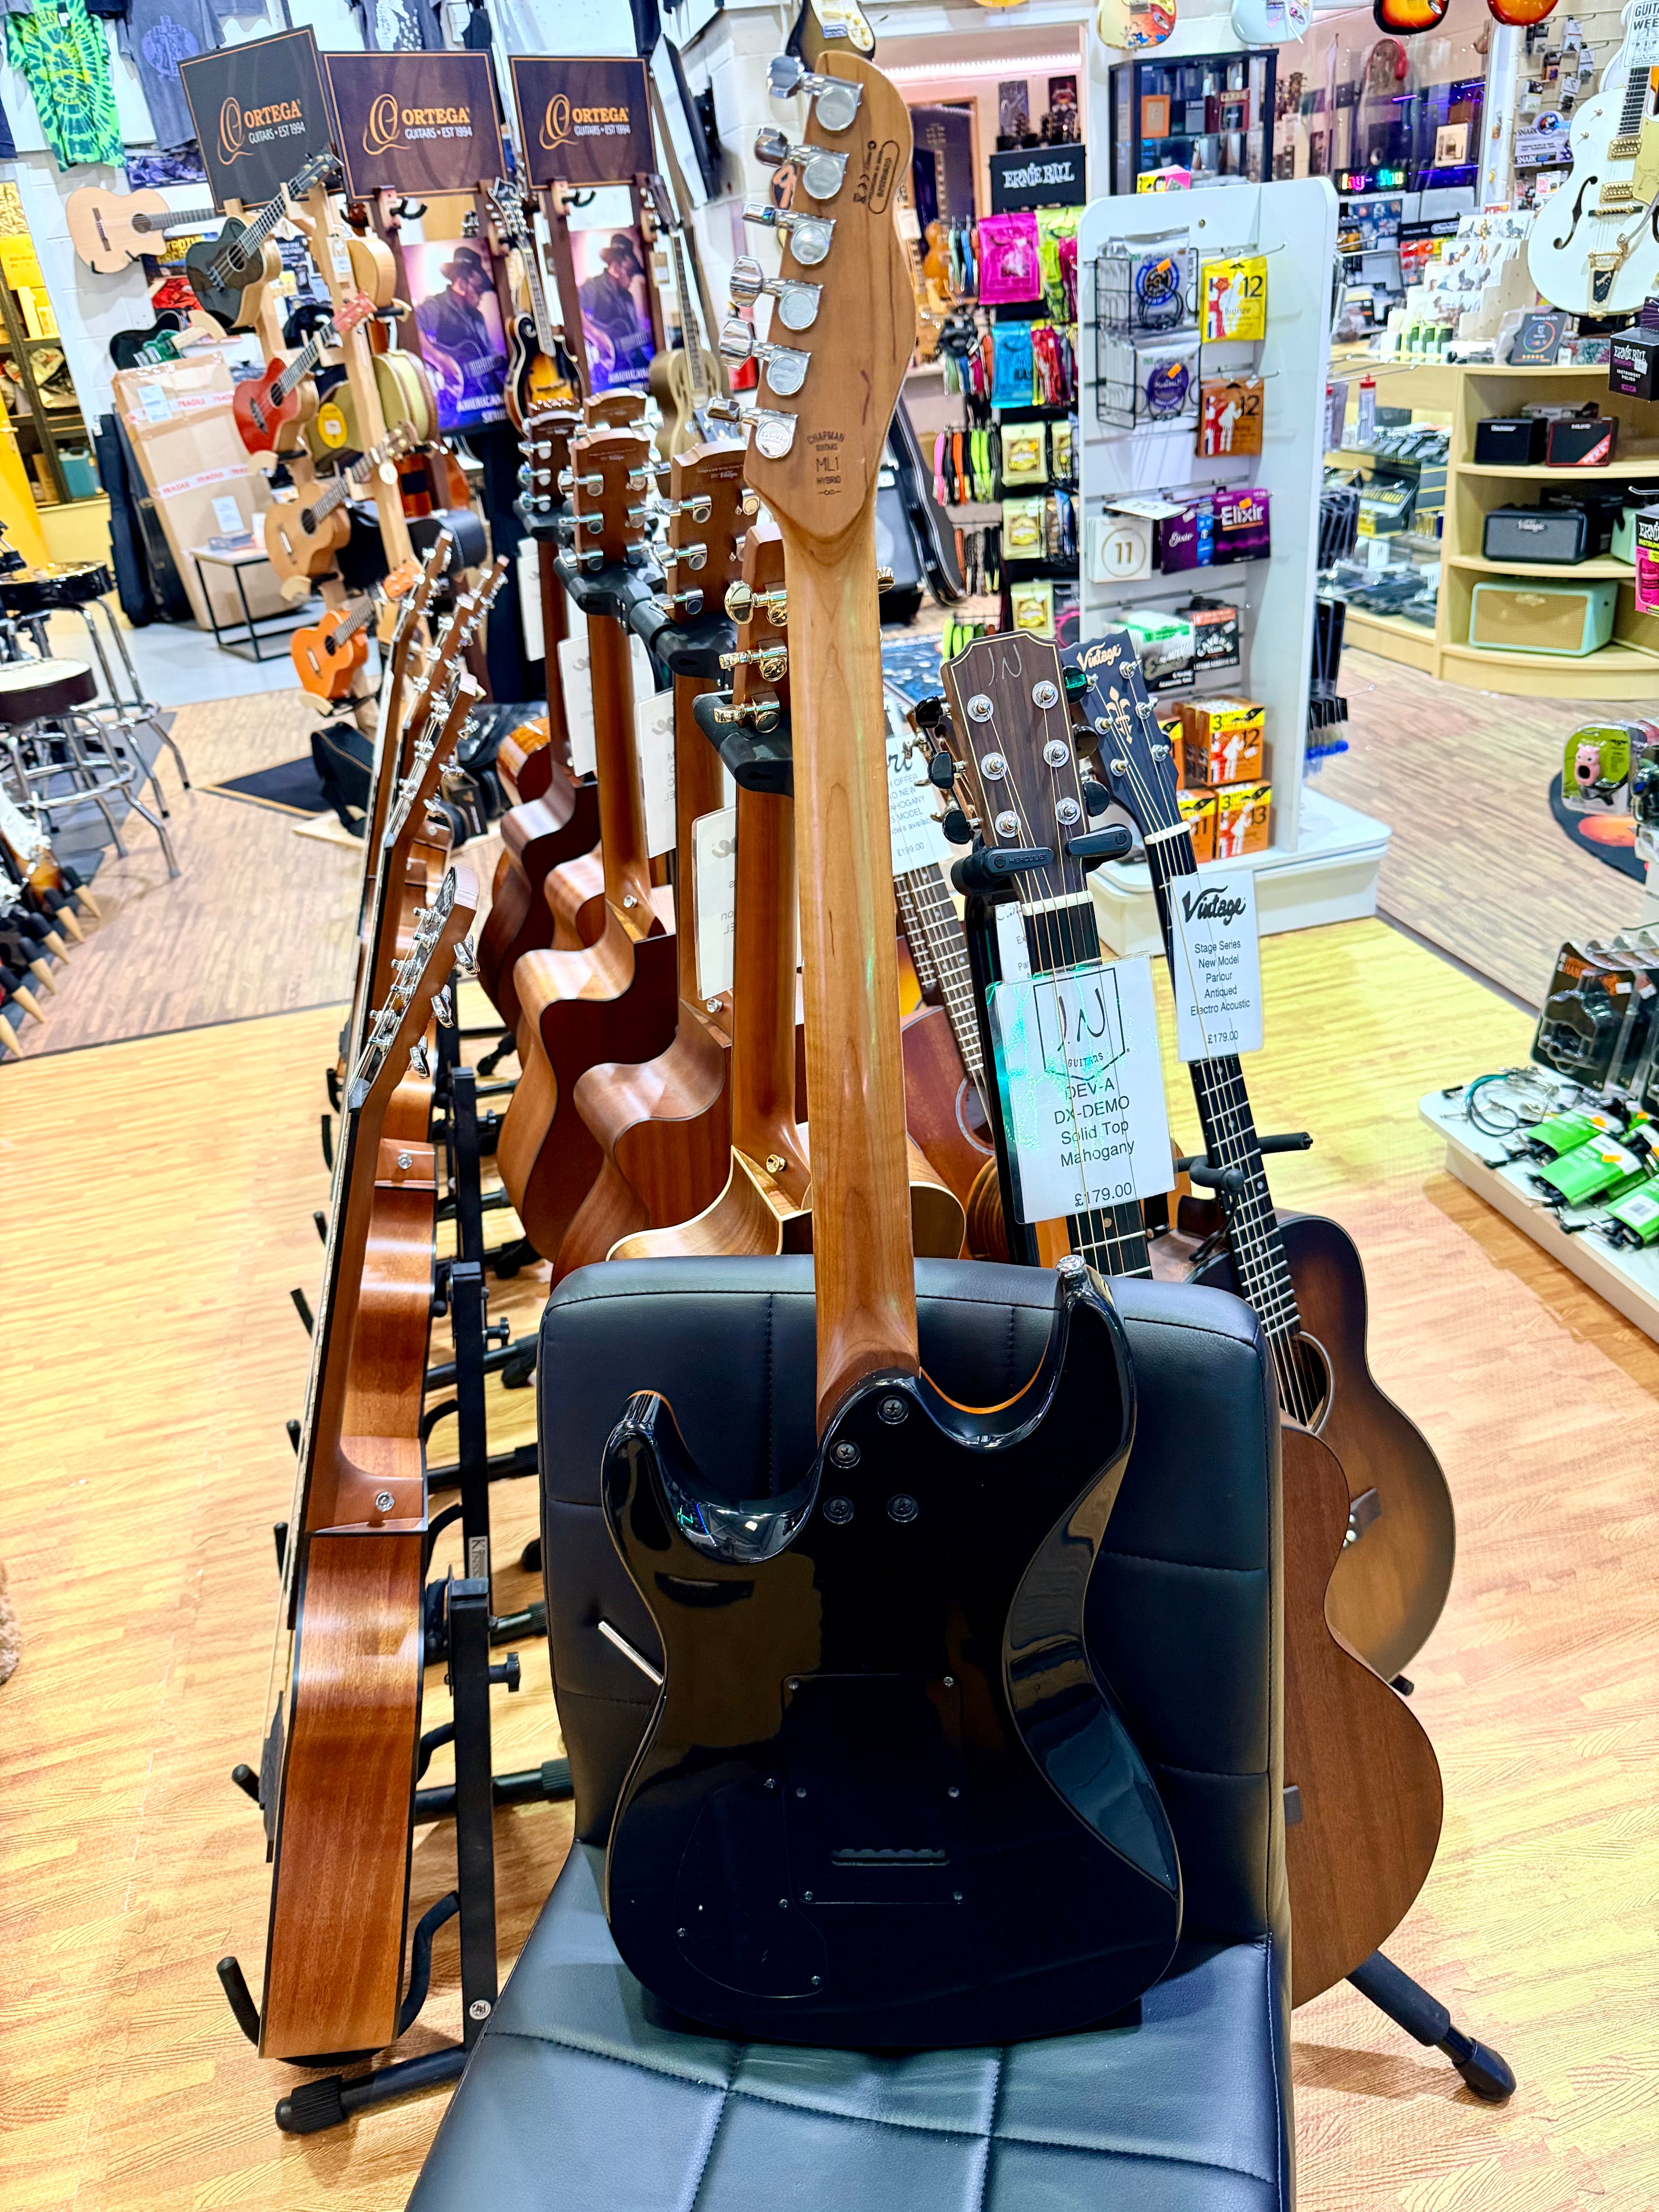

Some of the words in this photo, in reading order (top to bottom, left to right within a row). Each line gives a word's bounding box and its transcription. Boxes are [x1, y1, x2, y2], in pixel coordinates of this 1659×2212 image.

[1635, 3, 1659, 17] GUIT
[1634, 18, 1659, 30] WEE
[244, 100, 302, 128] ORTEGA
[402, 107, 470, 125] ORTEGA
[572, 107, 629, 123] ORTEGA
[1042, 161, 1075, 184] BALL
[1243, 275, 1263, 297] 12
[1614, 344, 1632, 361] ERNIE
[1631, 349, 1647, 362] BALL
[1240, 395, 1259, 416] 12
[807, 431, 845, 445] CHAPMAN
[816, 457, 839, 472] ML1
[817, 476, 841, 484] HYBRID
[1222, 503, 1264, 526] Elixir
[1638, 521, 1659, 541] ERNI
[1115, 541, 1132, 564] 11
[1077, 642, 1122, 673] Vintage
[1212, 714, 1222, 731] 3
[1243, 728, 1259, 749] 12
[894, 773, 918, 787] OFFER
[902, 786, 917, 796] NEW
[890, 794, 925, 811] AHOGANY
[897, 807, 924, 821] MODEL
[1251, 806, 1266, 825] 13
[896, 842, 925, 857] £199.00
[1009, 854, 1048, 864] HERCULES
[1182, 885, 1246, 926] Vintage
[1195, 943, 1217, 954] Stage
[1219, 939, 1241, 951] Series
[1199, 959, 1216, 969] New
[1218, 954, 1239, 966] Model
[1206, 972, 1232, 983] Parlour
[1204, 985, 1237, 999] Antiqued
[1191, 1005, 1219, 1016] Electro
[1221, 998, 1250, 1012] Acoustic
[1207, 1030, 1238, 1044] £179.00
[1068, 1053, 1103, 1067] GUITARS
[1065, 1078, 1115, 1100] DEV-A
[1054, 1096, 1130, 1125] DX-DEMO
[1061, 1125, 1097, 1145] Solid
[1102, 1121, 1129, 1135] Top
[1061, 1140, 1135, 1167] Mahogany
[1074, 1182, 1132, 1207] £179.00
